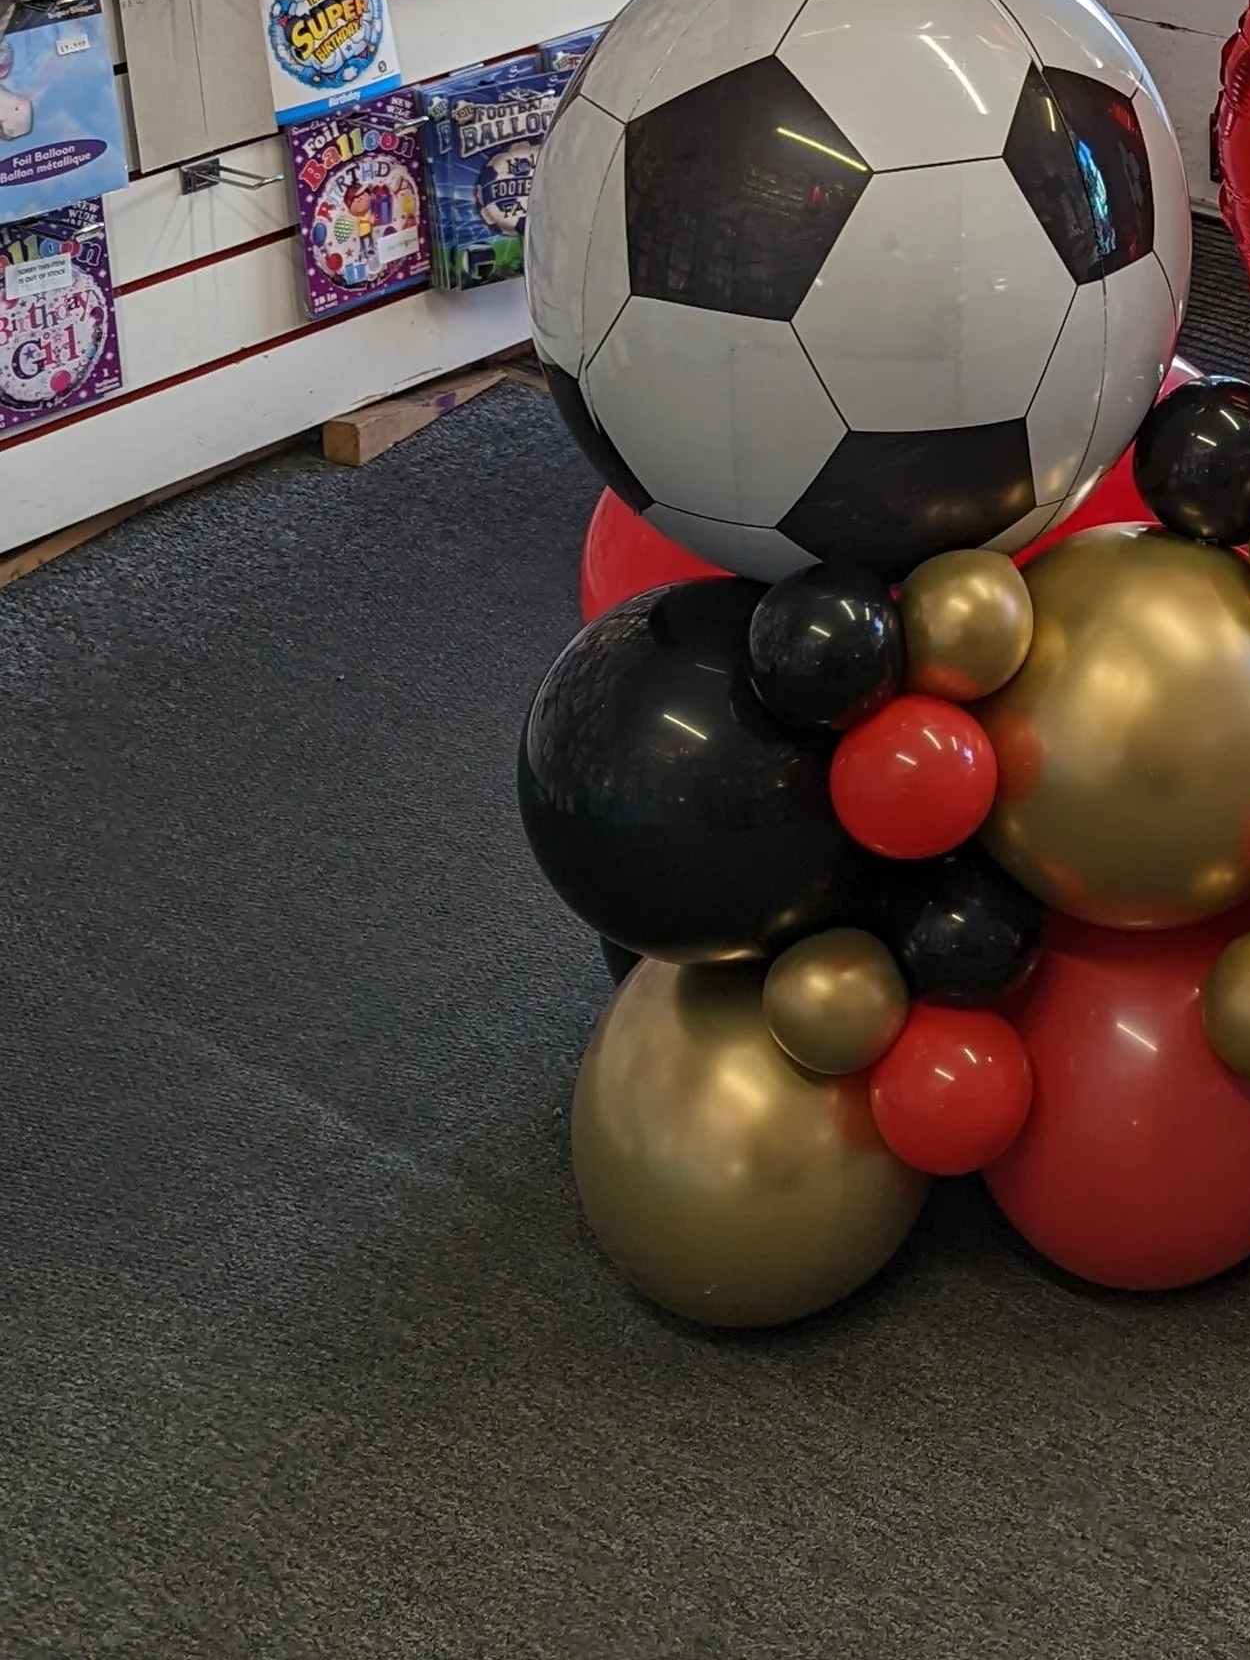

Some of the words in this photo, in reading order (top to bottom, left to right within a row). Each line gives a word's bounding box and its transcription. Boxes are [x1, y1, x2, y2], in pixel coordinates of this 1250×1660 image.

[328, 90, 362, 108] Birthday
[13, 155, 32, 170] Foil
[34, 145, 76, 163] Balloon
[302, 120, 341, 158] Foil
[0, 167, 36, 184] Ballon
[37, 152, 92, 172] métallique
[299, 126, 418, 192] Balloon
[0, 289, 90, 347] Birthday
[12, 324, 80, 380] Girl
